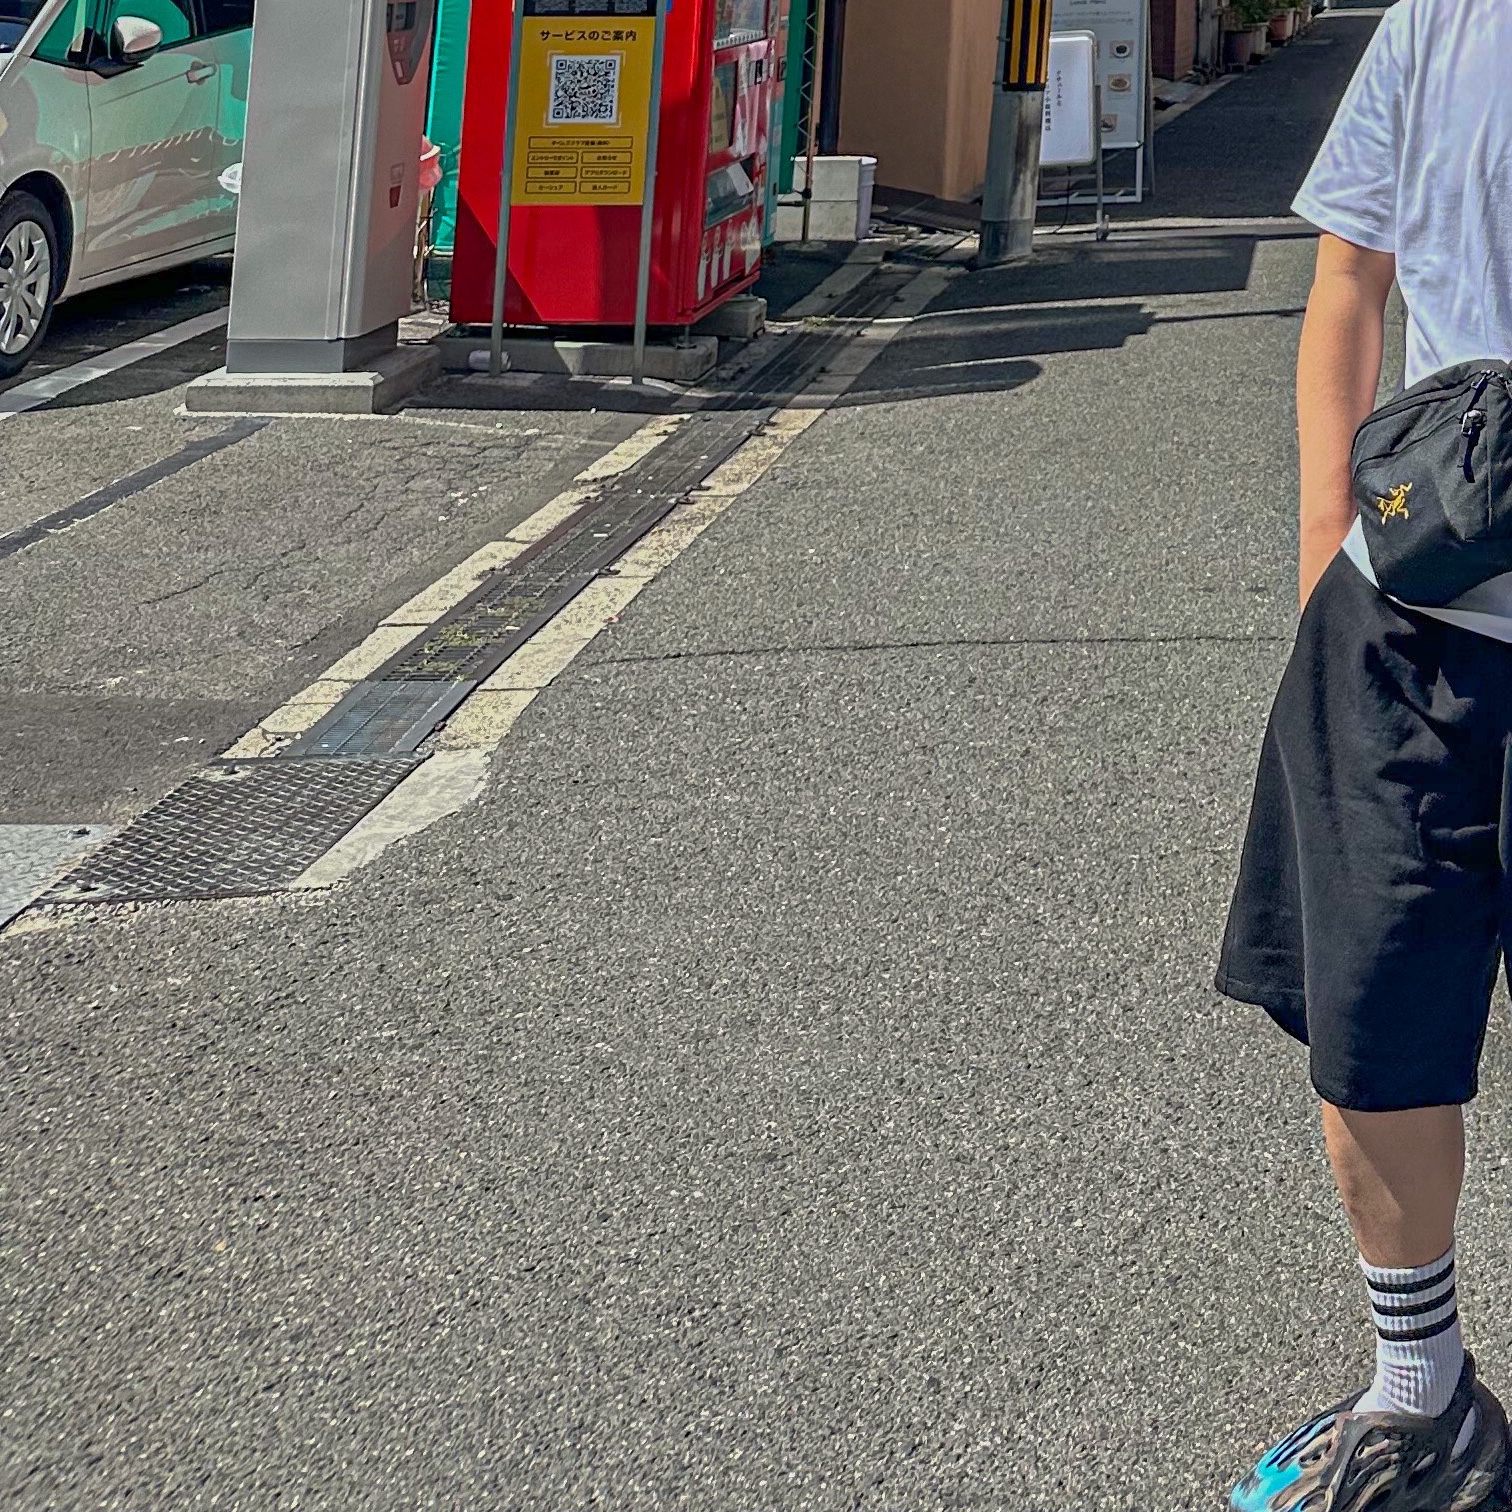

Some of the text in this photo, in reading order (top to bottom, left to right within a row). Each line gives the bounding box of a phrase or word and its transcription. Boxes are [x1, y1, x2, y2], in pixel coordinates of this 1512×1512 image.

[540, 29, 637, 42] サービスのご案内
